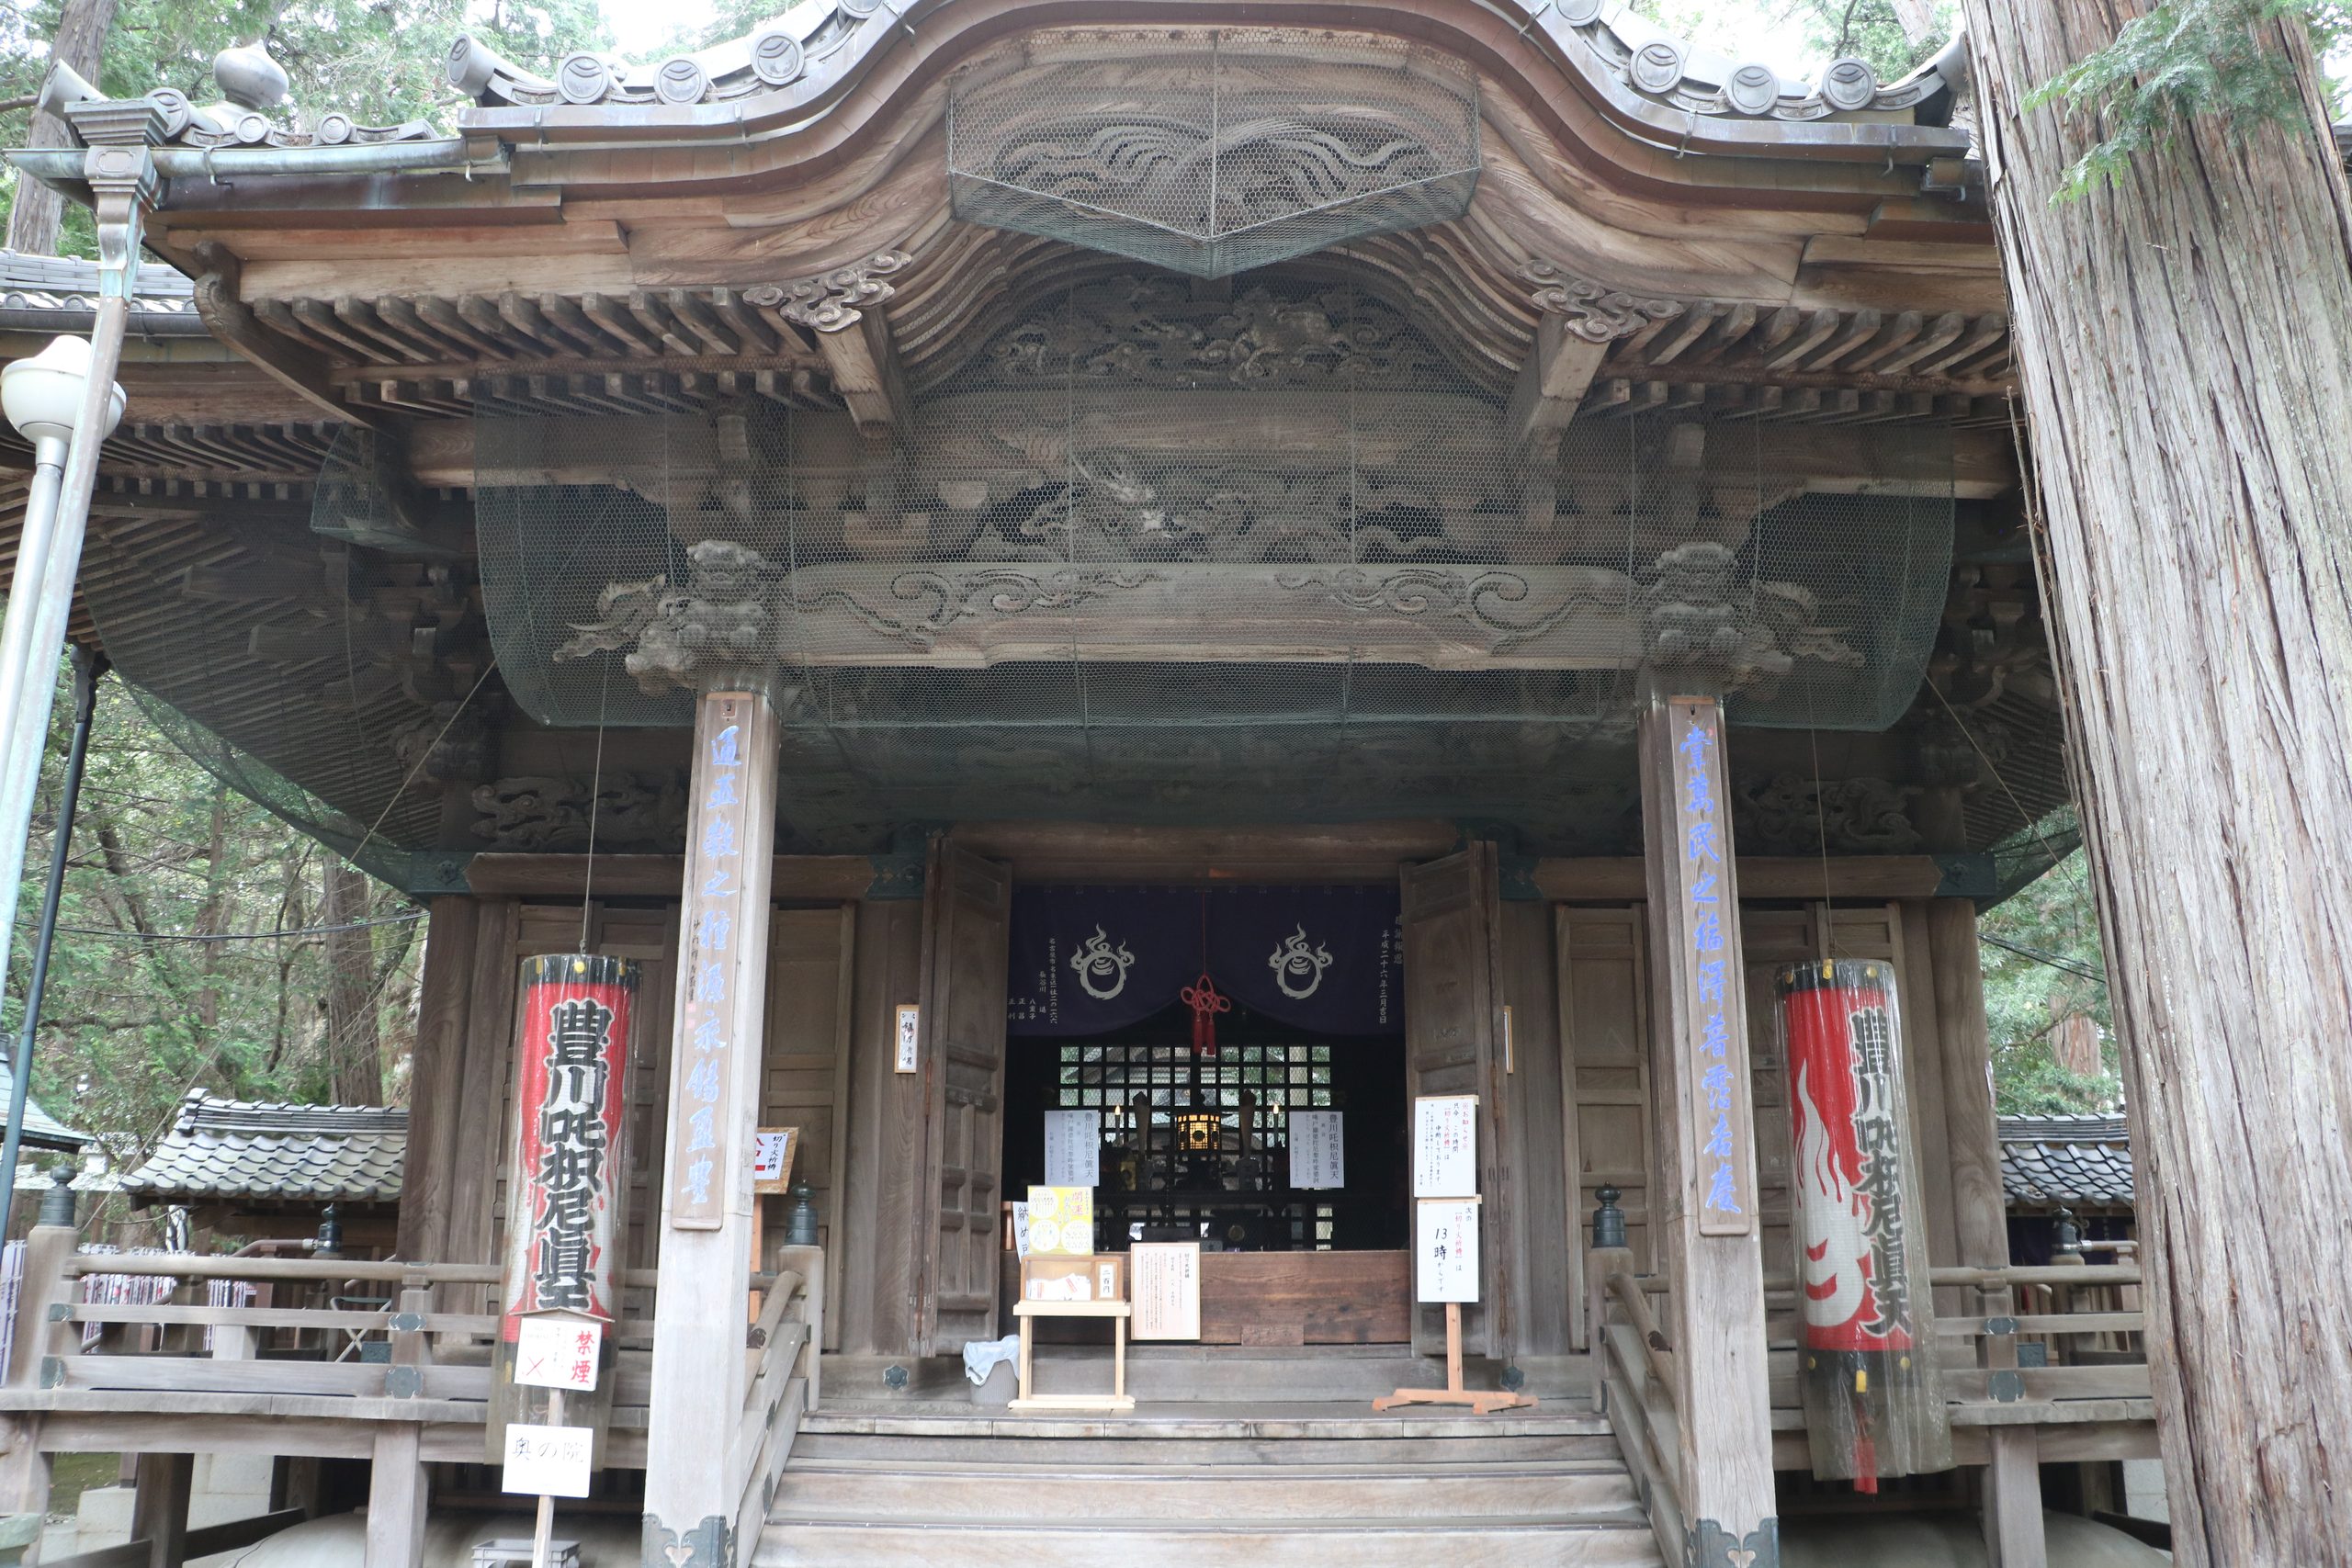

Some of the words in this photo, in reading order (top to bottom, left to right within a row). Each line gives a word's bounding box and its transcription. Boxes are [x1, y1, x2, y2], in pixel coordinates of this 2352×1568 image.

[571, 1330, 595, 1383] 禁煙
[512, 1437, 584, 1463] 奥の院
